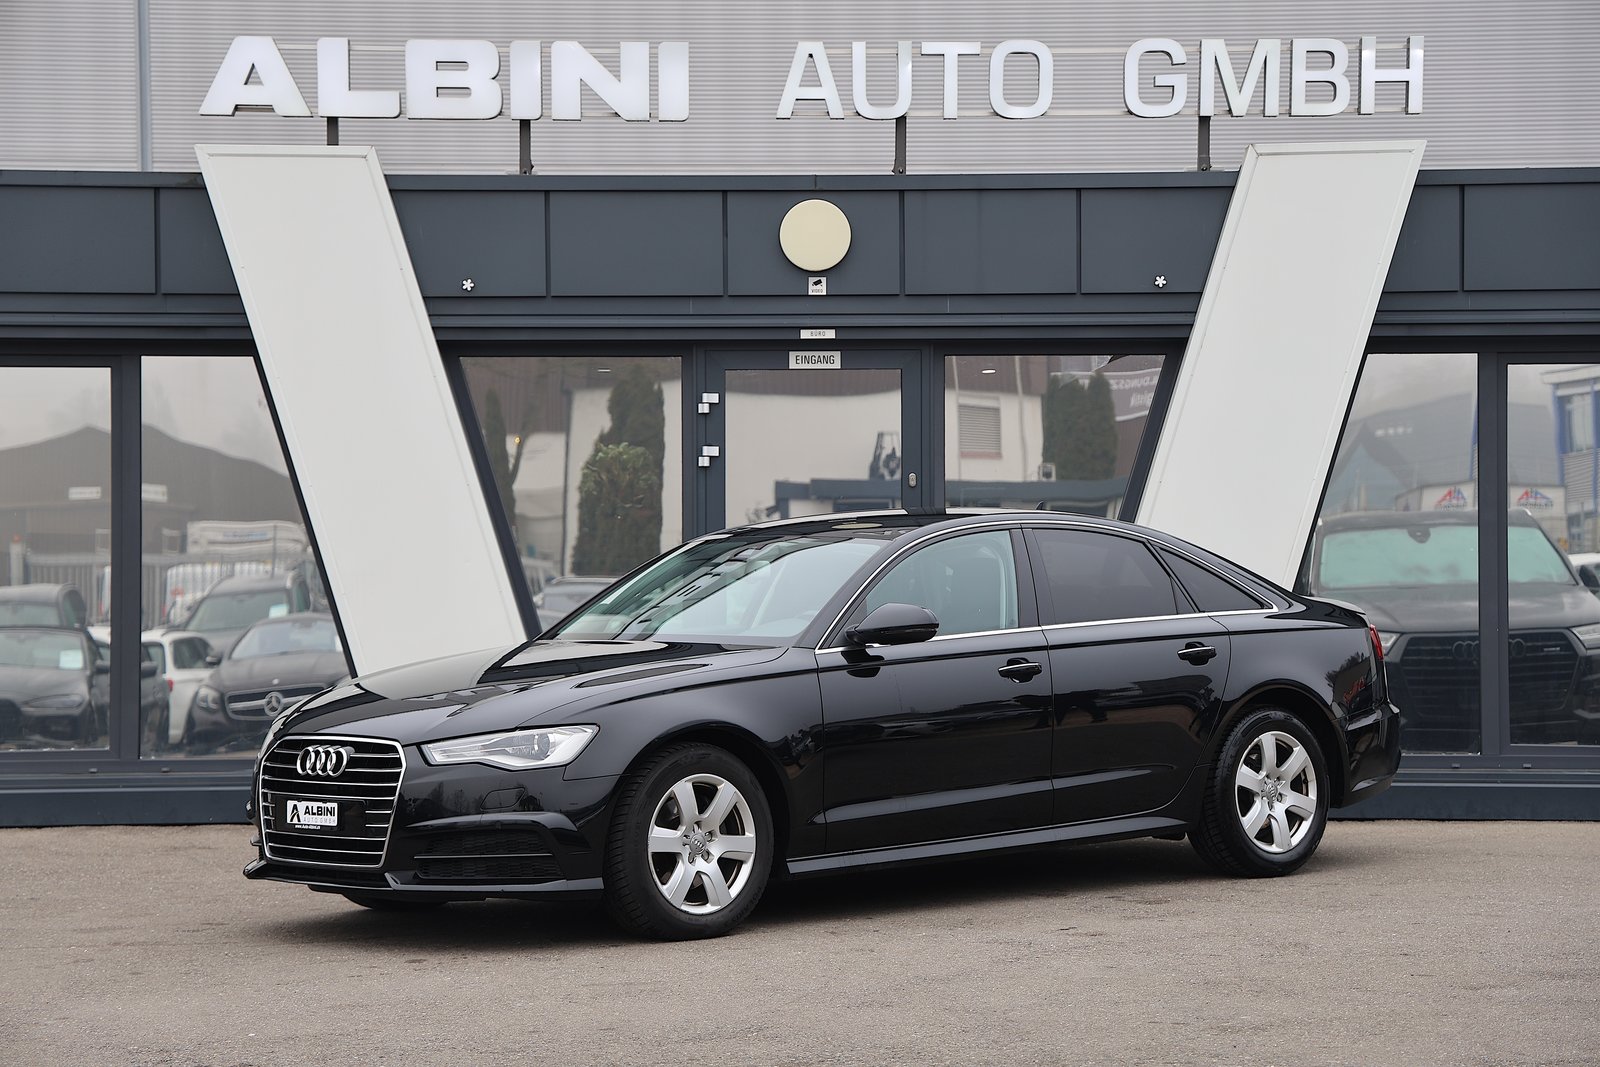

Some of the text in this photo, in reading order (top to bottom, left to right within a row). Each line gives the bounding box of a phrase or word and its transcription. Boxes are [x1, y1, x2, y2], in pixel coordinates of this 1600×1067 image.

[200, 35, 1425, 121] ALBINI AUTO GMBH
[795, 355, 835, 364] EINGANG
[304, 806, 335, 816] ALBINI
